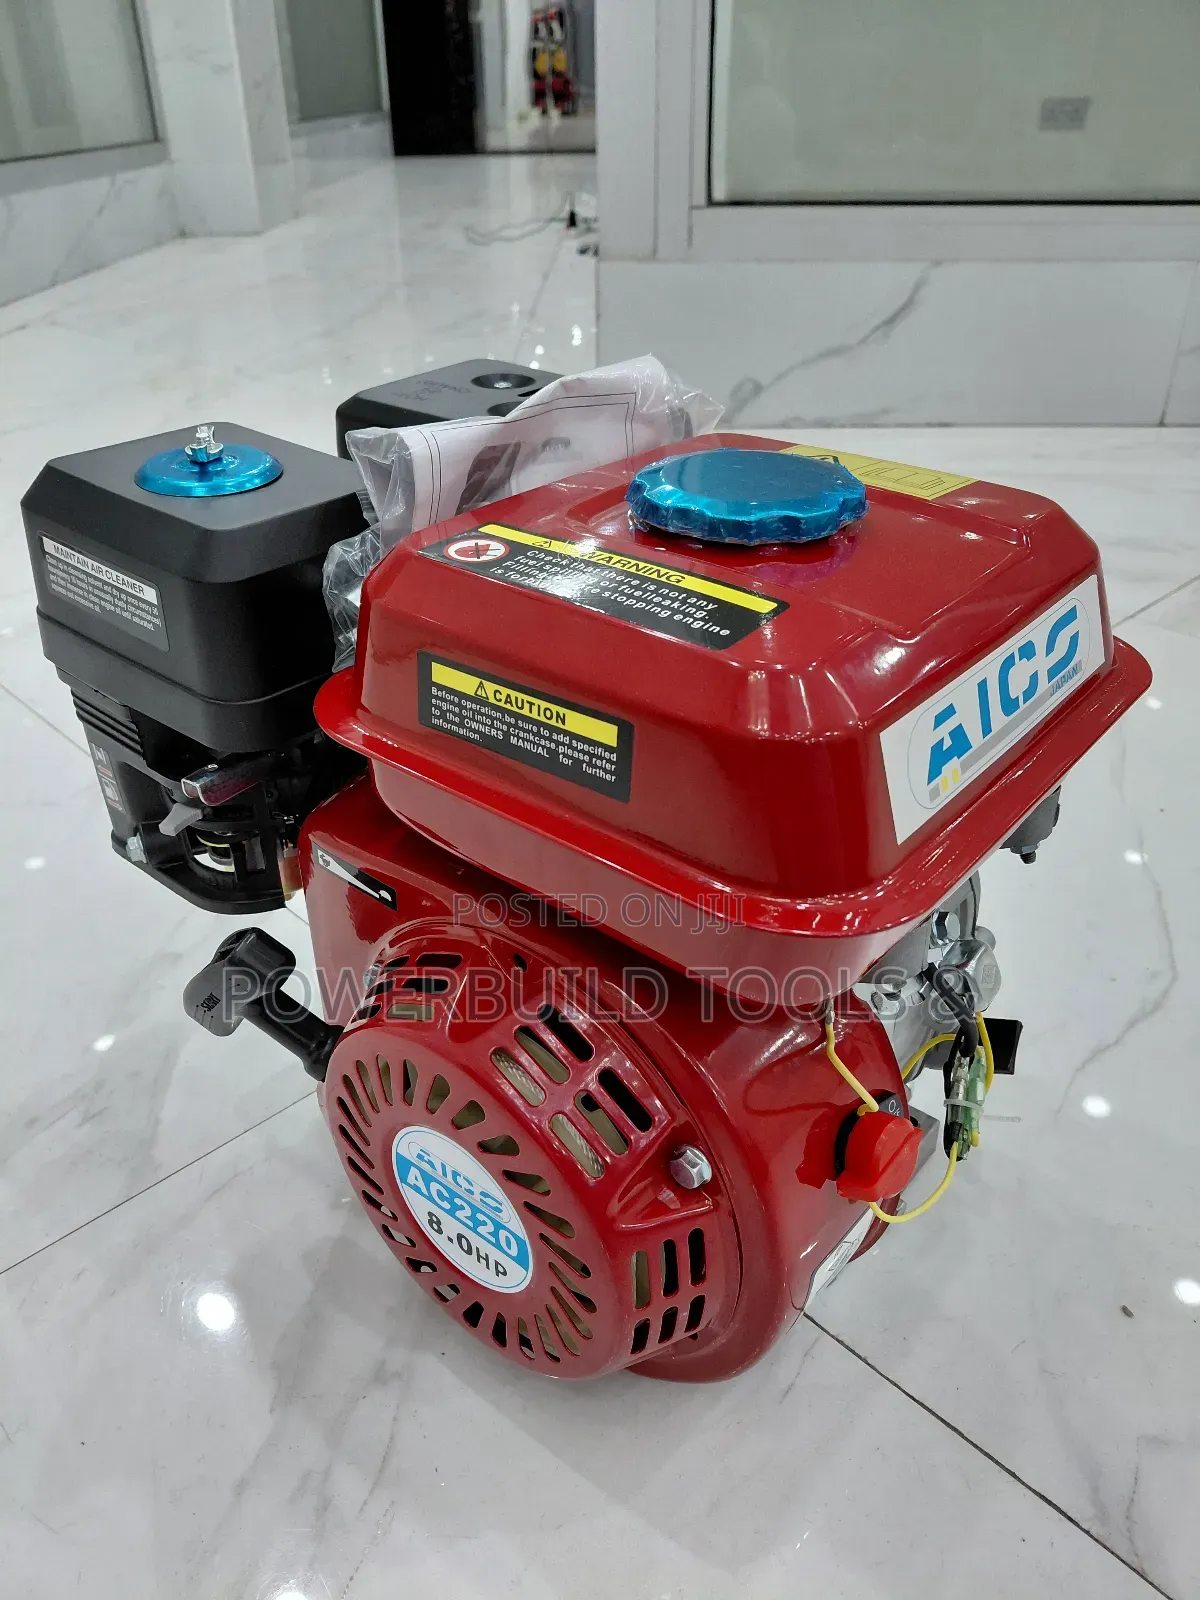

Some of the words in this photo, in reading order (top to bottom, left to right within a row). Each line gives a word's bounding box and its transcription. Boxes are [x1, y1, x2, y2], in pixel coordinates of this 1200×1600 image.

[53, 544, 90, 570] MAINTAIN
[91, 562, 105, 578] AIR
[105, 569, 146, 597] CLEANER
[490, 566, 505, 575] is
[502, 561, 548, 579] Filling
[601, 591, 672, 618] stopping
[673, 613, 731, 637] engine
[513, 555, 545, 568] fuel
[600, 580, 619, 589] or
[527, 550, 569, 566] Check
[570, 562, 601, 574] that
[601, 569, 641, 587] there
[642, 581, 657, 592] is
[658, 588, 688, 601] not
[689, 598, 719, 612] any
[493, 688, 567, 727] CAUTION
[926, 604, 1080, 786] AICS
[1050, 663, 1079, 698] JAPAN
[431, 686, 459, 704] Before
[517, 719, 539, 733] sure
[540, 725, 550, 737] to
[551, 730, 571, 745] add
[571, 738, 618, 763] specified
[431, 716, 483, 743] information.
[431, 697, 460, 715] engine
[461, 708, 473, 719] oil
[474, 711, 492, 726] into
[493, 719, 508, 732] the
[592, 757, 617, 774] refer
[431, 706, 441, 717] to
[446, 711, 460, 724] the
[464, 718, 504, 741] OWNERS
[510, 736, 550, 759] MANUAL
[559, 753, 573, 767] for
[582, 763, 617, 783] further
[406, 1165, 519, 1257] AC220
[427, 1210, 508, 1278] 8.0HP
